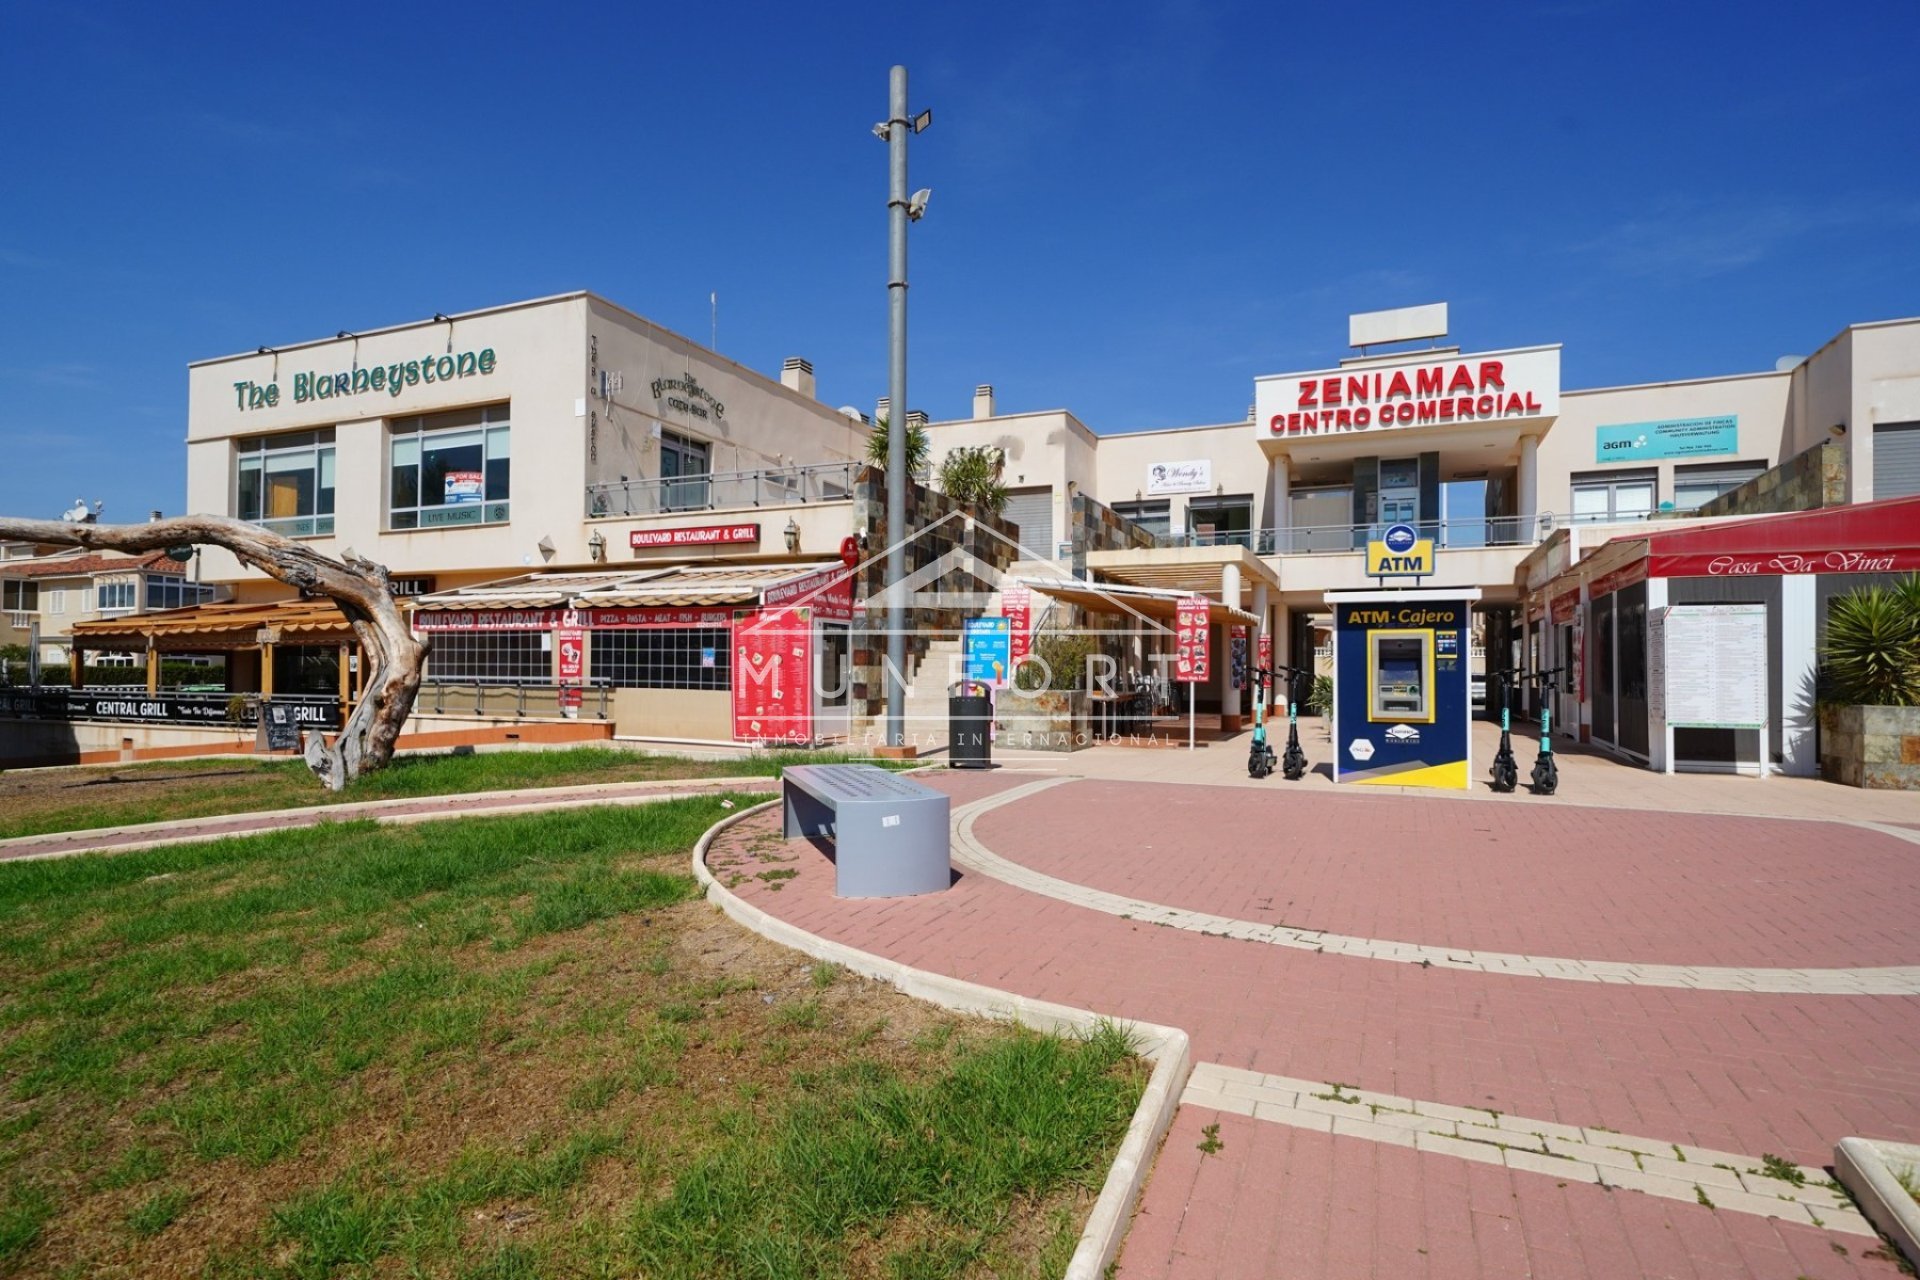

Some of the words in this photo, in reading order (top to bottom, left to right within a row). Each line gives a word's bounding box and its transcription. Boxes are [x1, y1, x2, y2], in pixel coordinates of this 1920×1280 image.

[1297, 361, 1506, 406] ZENIAMAR
[233, 380, 280, 411] The
[1270, 406, 1371, 433] CENTRO
[1378, 391, 1542, 424] COMERCIAL
[428, 513, 444, 523] LIVE
[447, 510, 476, 521] MUSIC
[632, 532, 672, 545] BOULEVARD
[674, 530, 720, 542] RESTAURANT
[723, 530, 730, 540] &
[733, 527, 755, 539] GRILL
[1378, 556, 1423, 572] ATM
[1707, 555, 1762, 575] Casa
[1768, 554, 1817, 573] Da
[1824, 551, 1896, 571] Vinci
[389, 580, 423, 596] RILL
[419, 612, 474, 629] BOULEVARD
[478, 611, 545, 628] RESTAURANT
[550, 612, 558, 628] &
[562, 610, 595, 628] GRILL
[600, 614, 620, 623] PIZZA
[626, 613, 647, 623] PASTA
[1348, 610, 1390, 624] ATM
[1398, 608, 1455, 625] Cajero
[96, 701, 138, 716] CENTRAL
[140, 702, 168, 717] GRILL
[293, 706, 327, 722] GRILL
